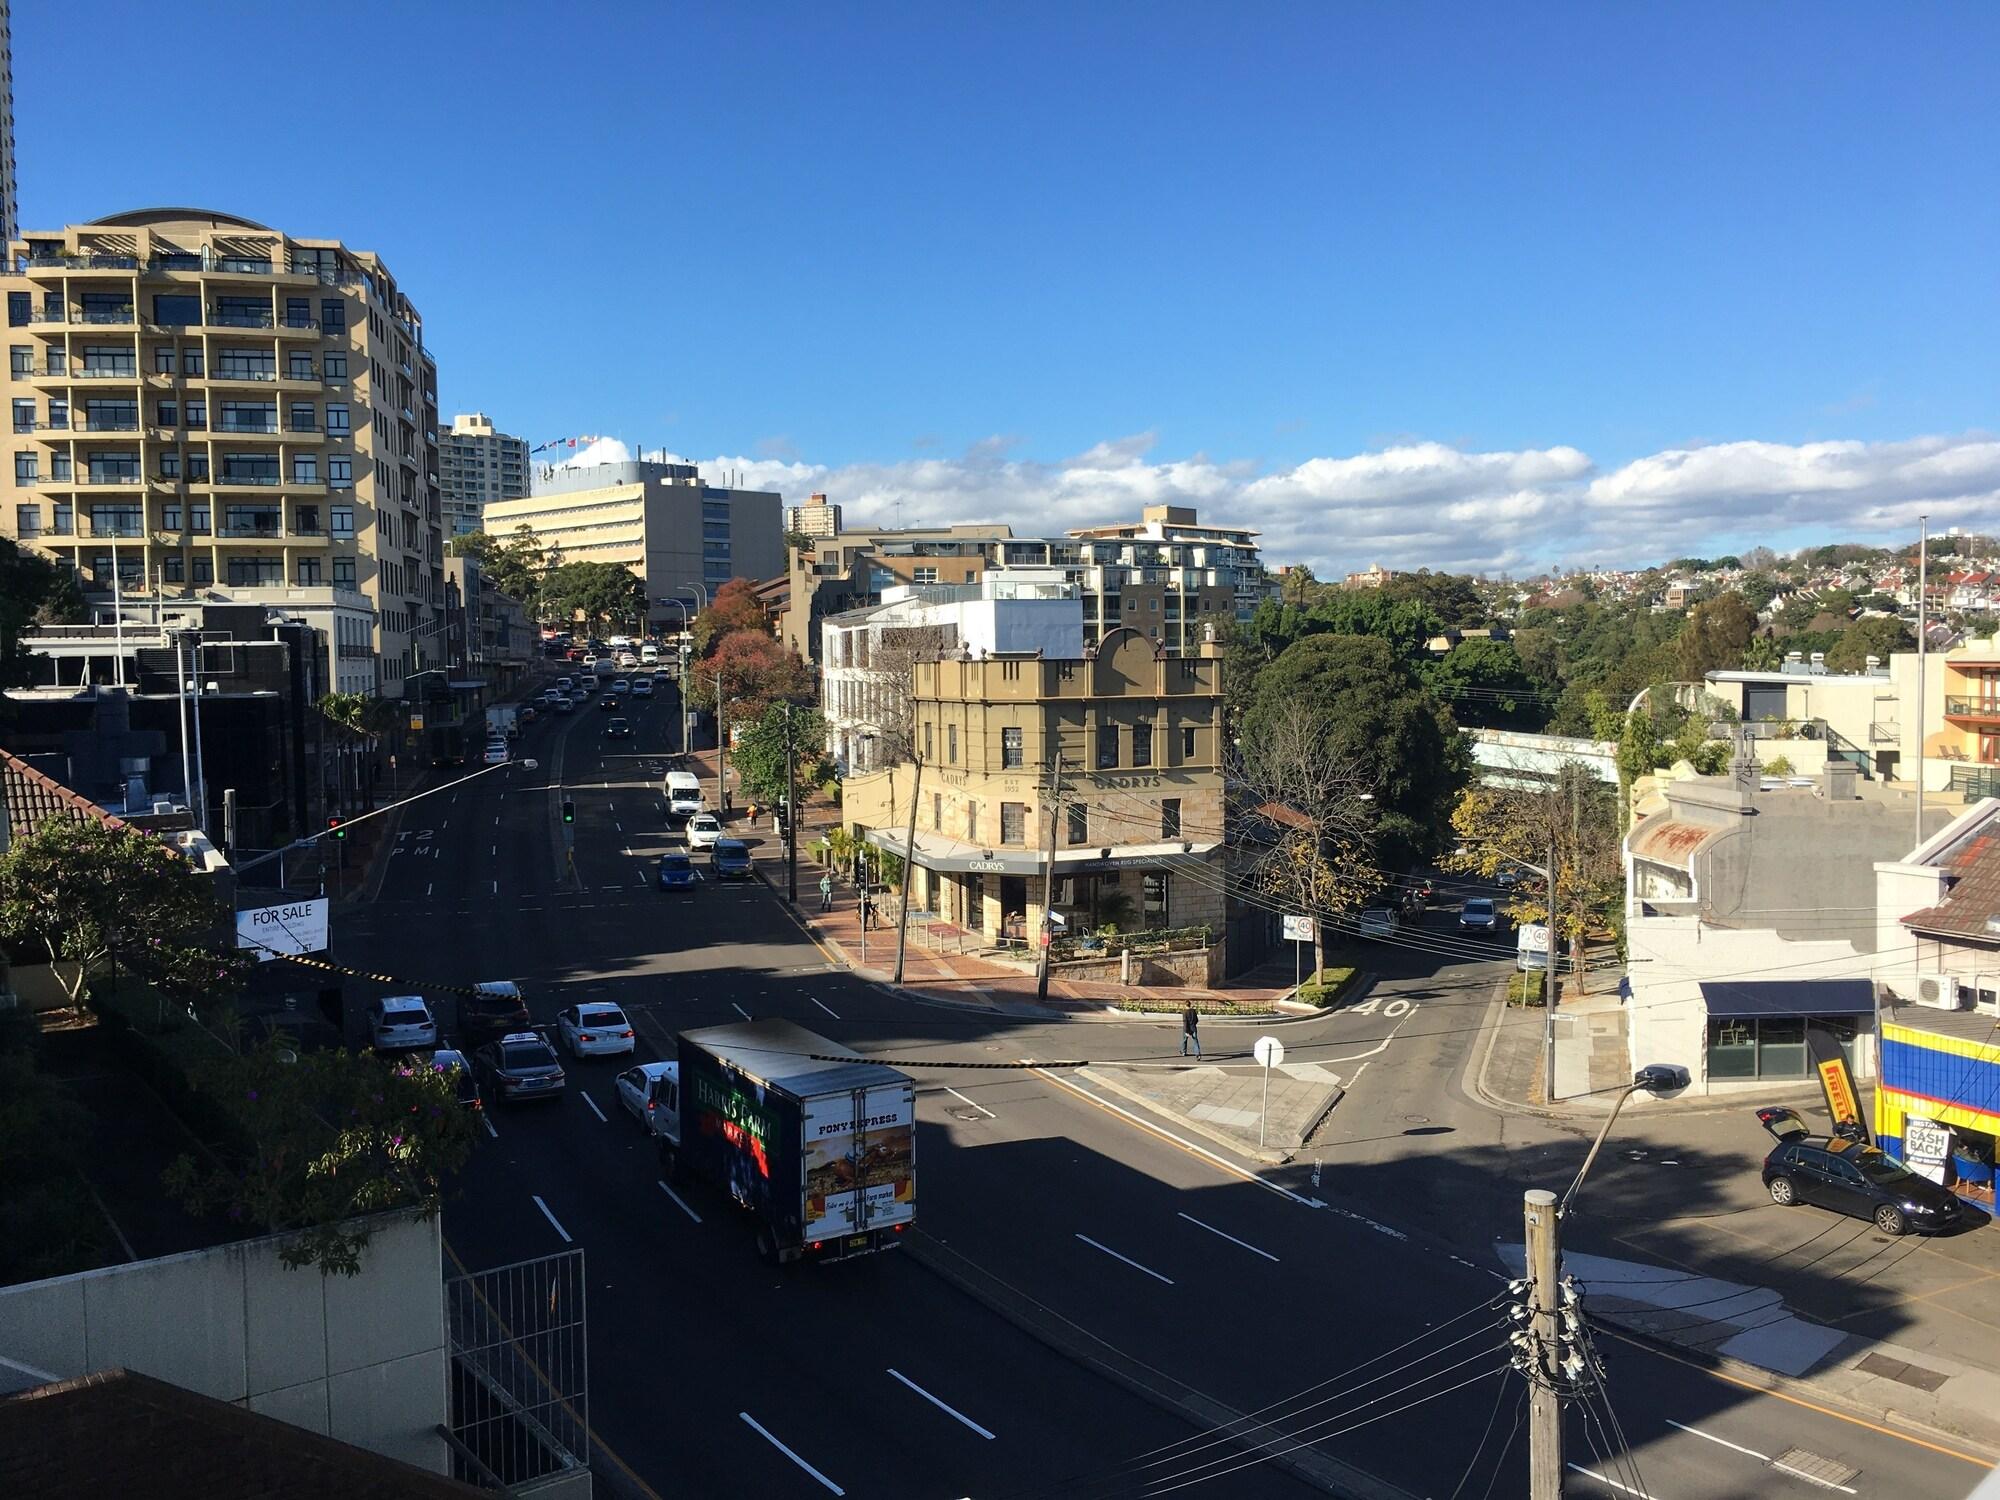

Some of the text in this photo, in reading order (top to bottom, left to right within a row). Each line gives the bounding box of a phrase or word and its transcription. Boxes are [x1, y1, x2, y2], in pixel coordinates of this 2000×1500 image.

[940, 773, 967, 786] CADRYS
[1094, 776, 1160, 790] CADRYS
[395, 830, 434, 841] T2
[969, 860, 1004, 870] CADRYS
[254, 904, 312, 926] FOR SALE
[1300, 922, 1310, 930] 40
[1536, 932, 1546, 940] 40
[1350, 998, 1410, 1017] 40
[698, 1079, 771, 1141] HARRIS FARM
[818, 1114, 898, 1136] PONY EXPRESS
[1910, 1130, 1945, 1146] CASH
[1910, 1140, 1943, 1157] BACK
